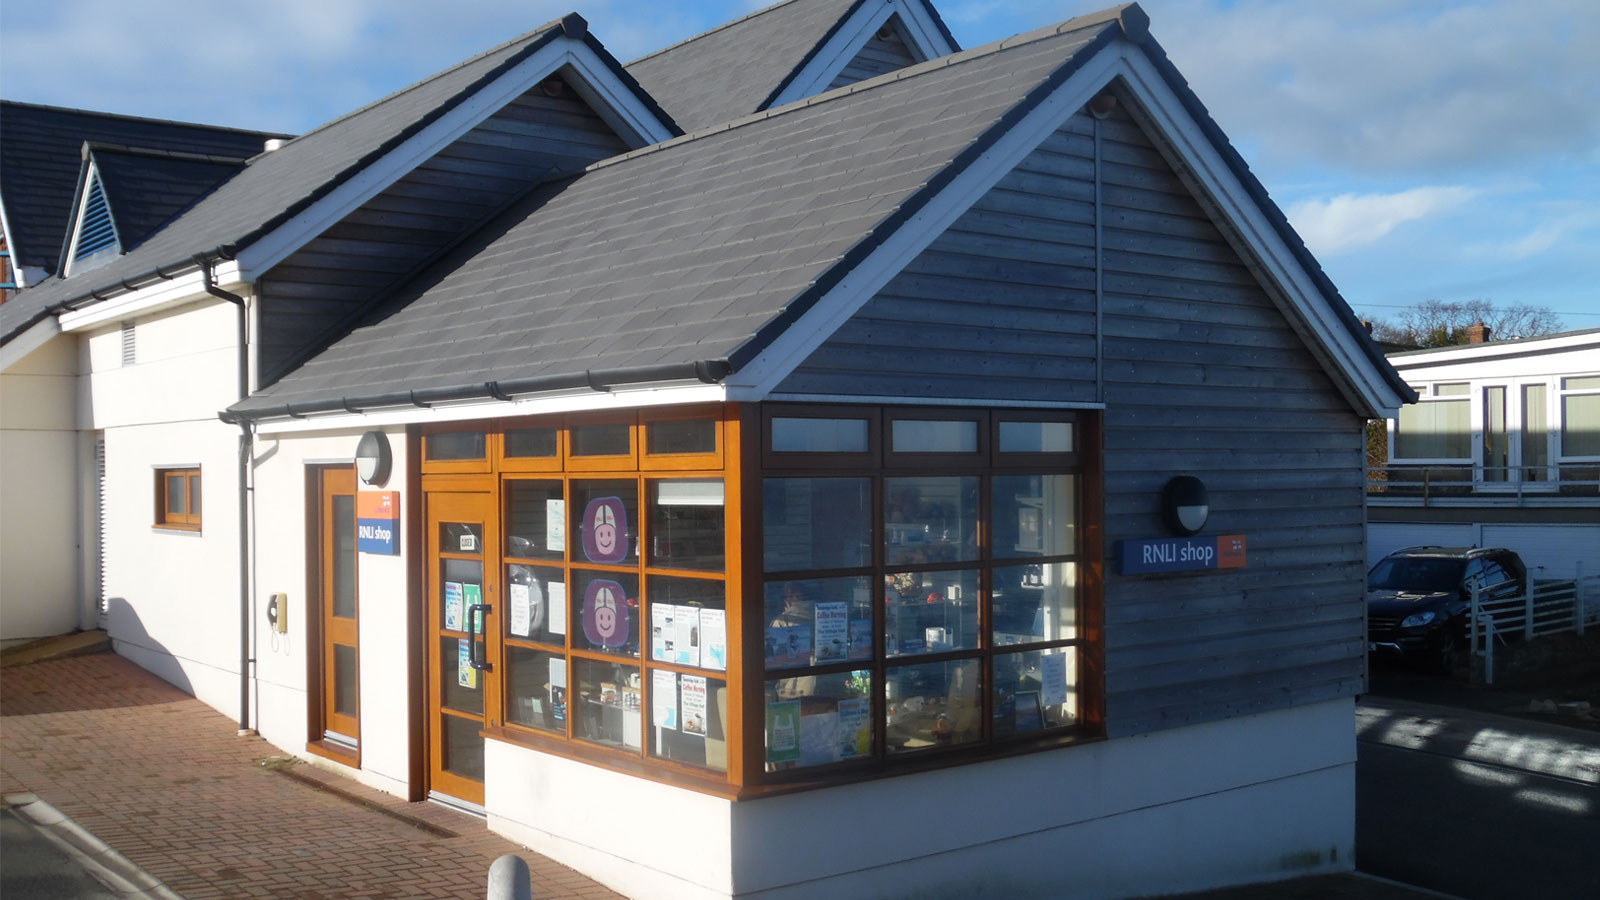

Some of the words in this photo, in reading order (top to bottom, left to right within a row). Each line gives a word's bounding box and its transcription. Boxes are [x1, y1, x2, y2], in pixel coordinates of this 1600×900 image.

[359, 525, 374, 539] RNLI
[375, 525, 391, 544] shop
[1143, 543, 1177, 564] RNLI
[1180, 541, 1214, 566] shop
